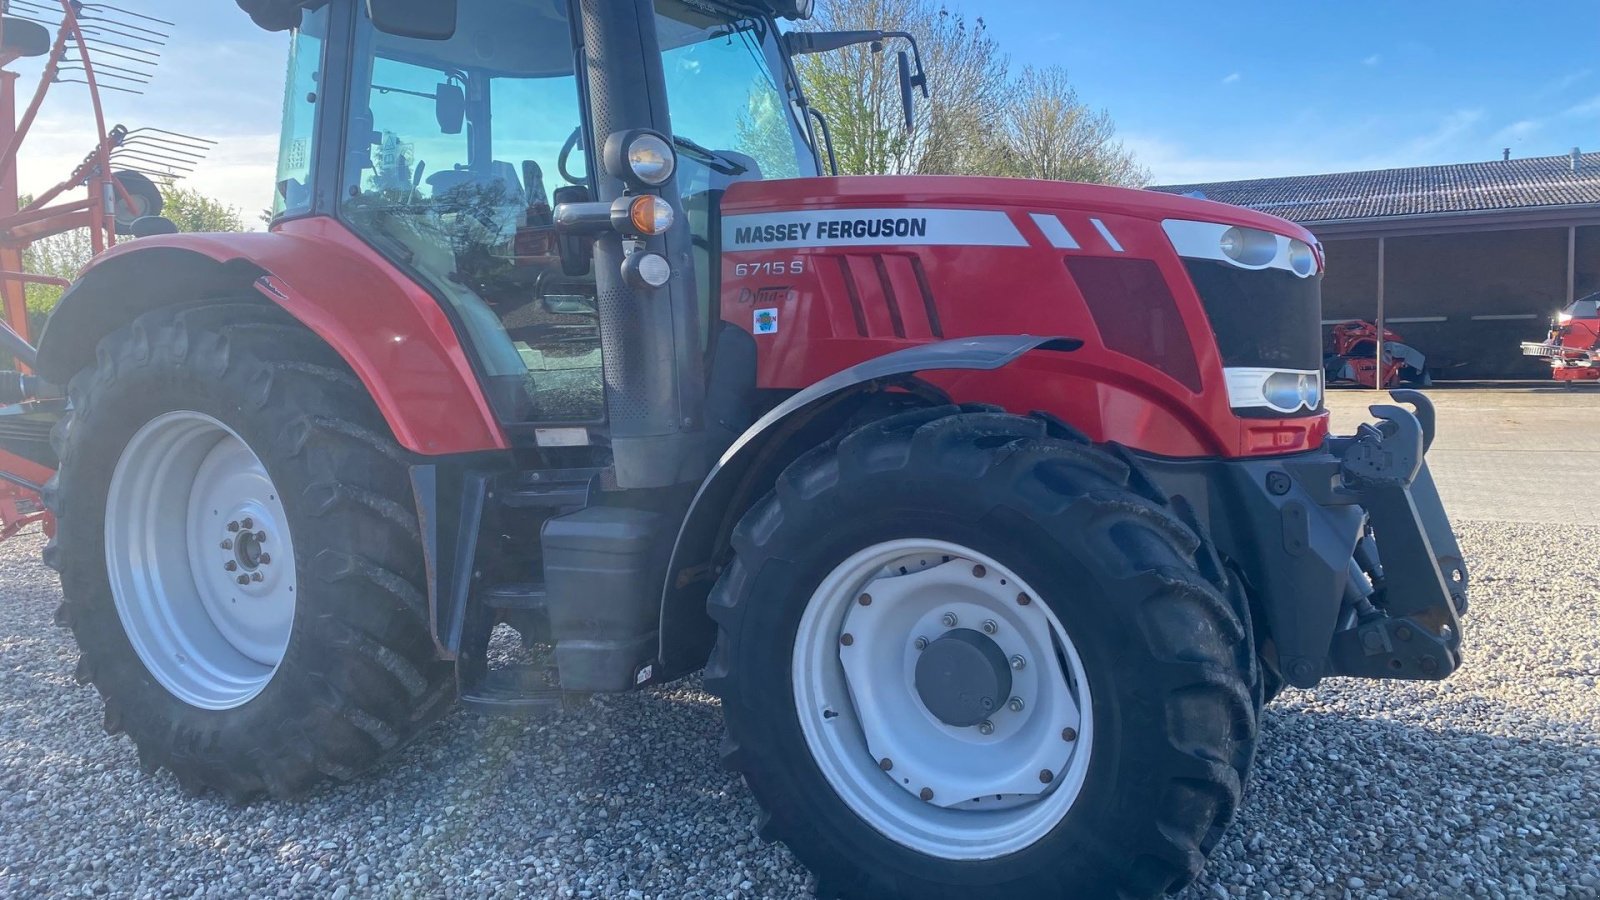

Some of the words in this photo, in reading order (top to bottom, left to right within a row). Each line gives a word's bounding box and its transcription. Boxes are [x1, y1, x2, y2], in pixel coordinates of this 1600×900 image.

[735, 222, 811, 244] MASSEY
[816, 218, 926, 239] FERGUSON
[734, 262, 785, 276] 6715
[791, 261, 804, 274] S
[738, 286, 793, 308] Dyna-6
